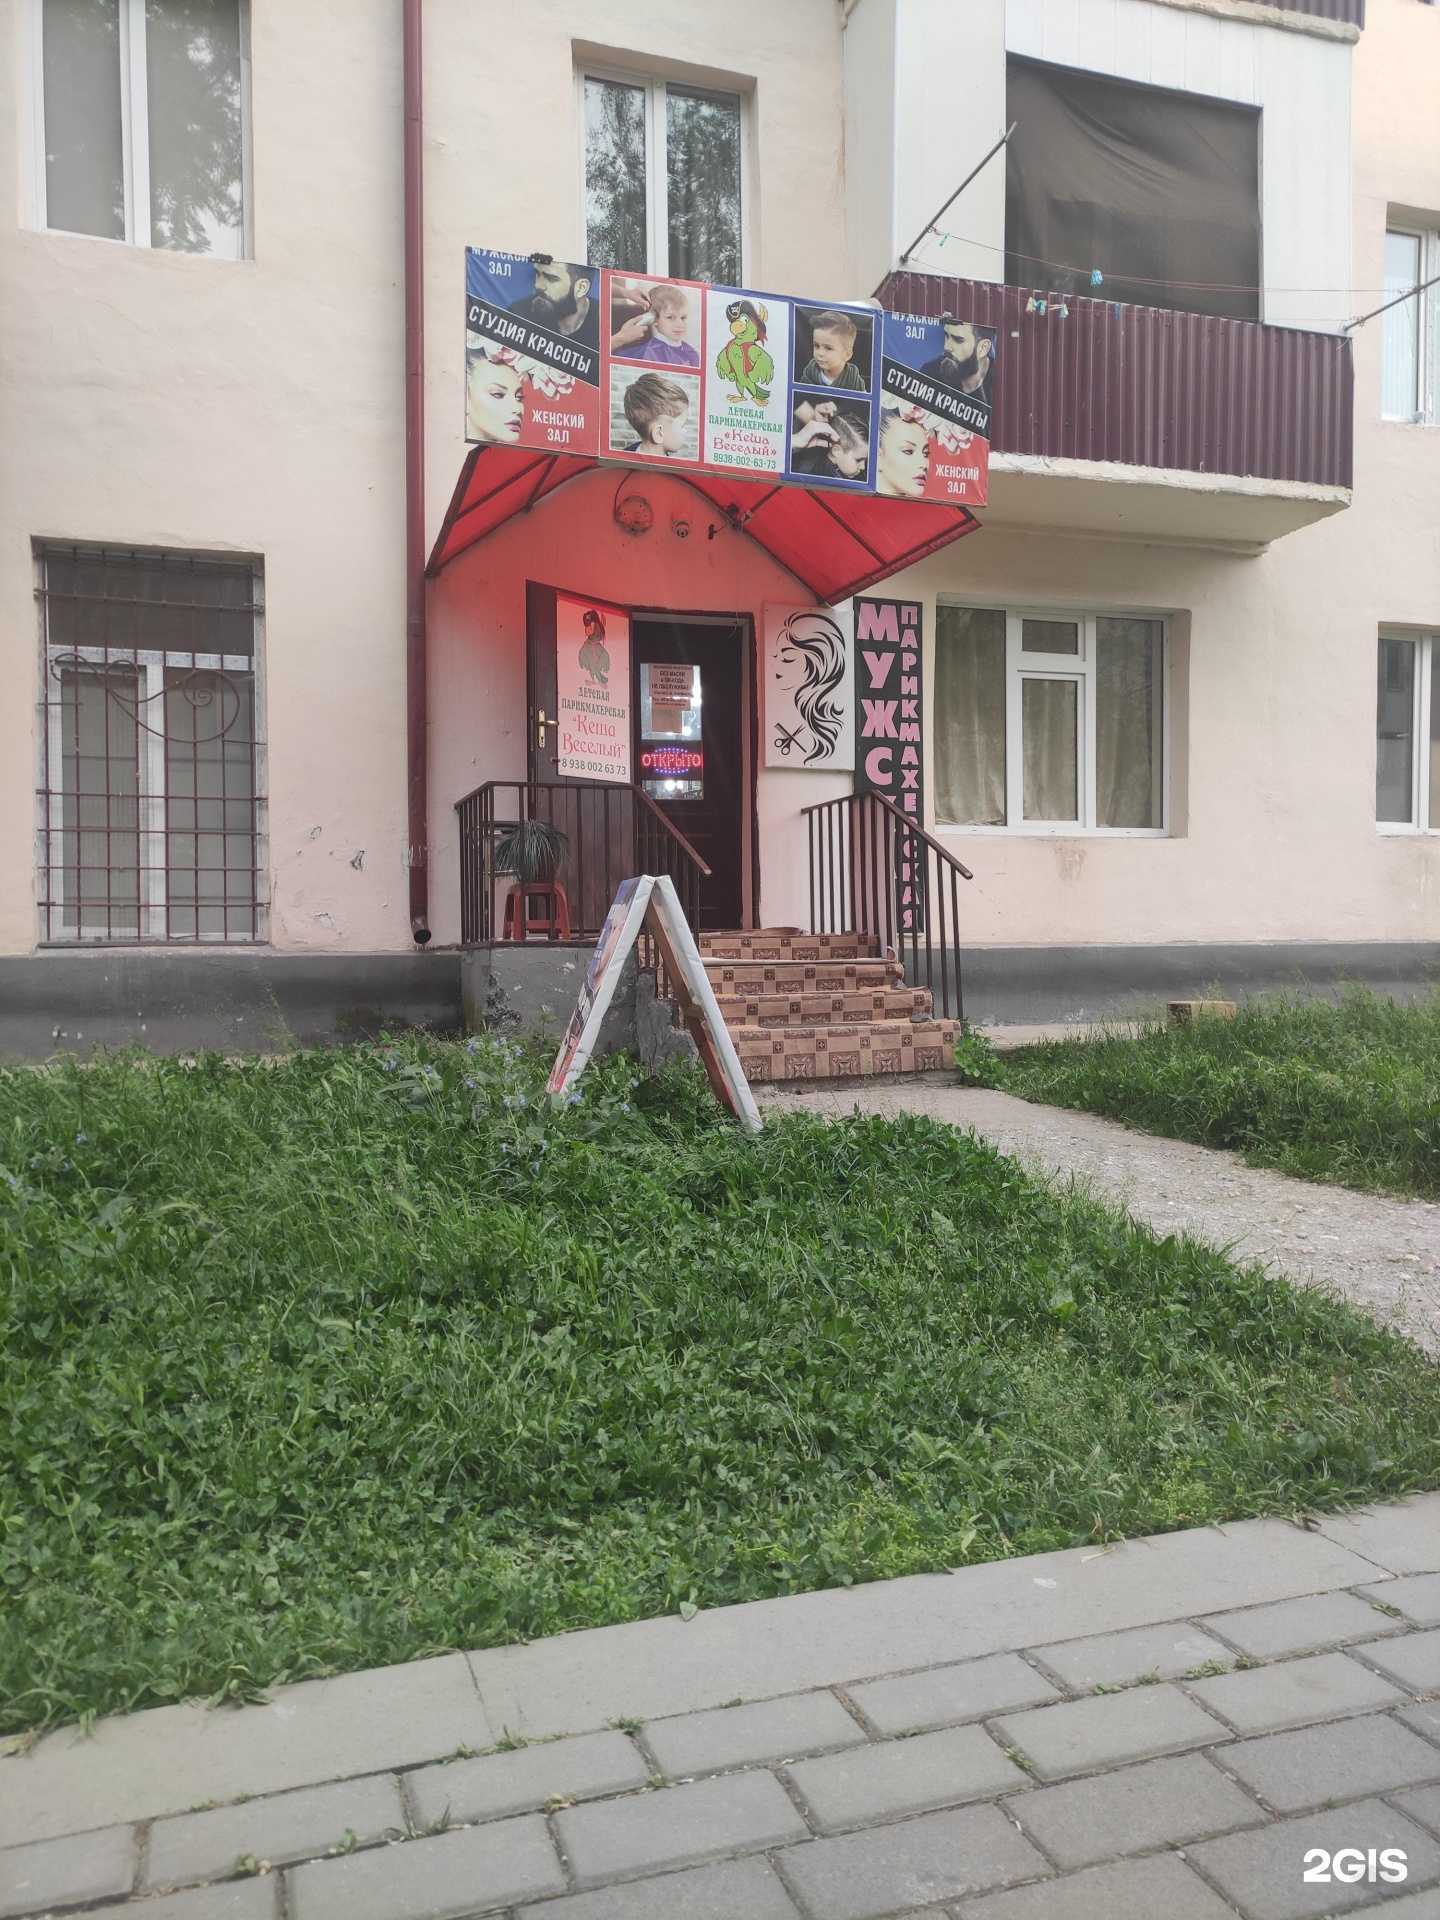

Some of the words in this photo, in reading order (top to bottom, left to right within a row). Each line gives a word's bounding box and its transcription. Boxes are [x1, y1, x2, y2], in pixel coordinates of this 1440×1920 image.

[488, 261, 512, 277] ЗАЛ
[468, 305, 527, 343] СТУДИЯ
[527, 334, 591, 374] КРАСОТЫ
[905, 325, 926, 340] ЗАЛ
[887, 368, 935, 402] СТУДИЯ
[935, 390, 988, 428] КРАСОТЫ
[531, 408, 585, 430] ЖЕНСКИЙ
[728, 406, 765, 420] ДЕТСКАЯ
[708, 414, 783, 433] ПАРИКМАХЕРСКАЯ
[547, 427, 570, 444] ЗАЛ
[713, 452, 777, 470] 8938-002-63-73
[935, 463, 980, 481] ЖЕНСКИЙ
[947, 480, 966, 495] ЗАЛ
[578, 687, 610, 701] ДЕТСКАЯ
[561, 698, 626, 719] ПАРИКМАХЕРСКАЯ
[561, 758, 568, 768] 8
[569, 759, 585, 770] 938
[587, 761, 603, 772] 002
[604, 763, 615, 774] 63
[616, 765, 626, 776] 73
[641, 752, 702, 768] ОТКРЫТО
